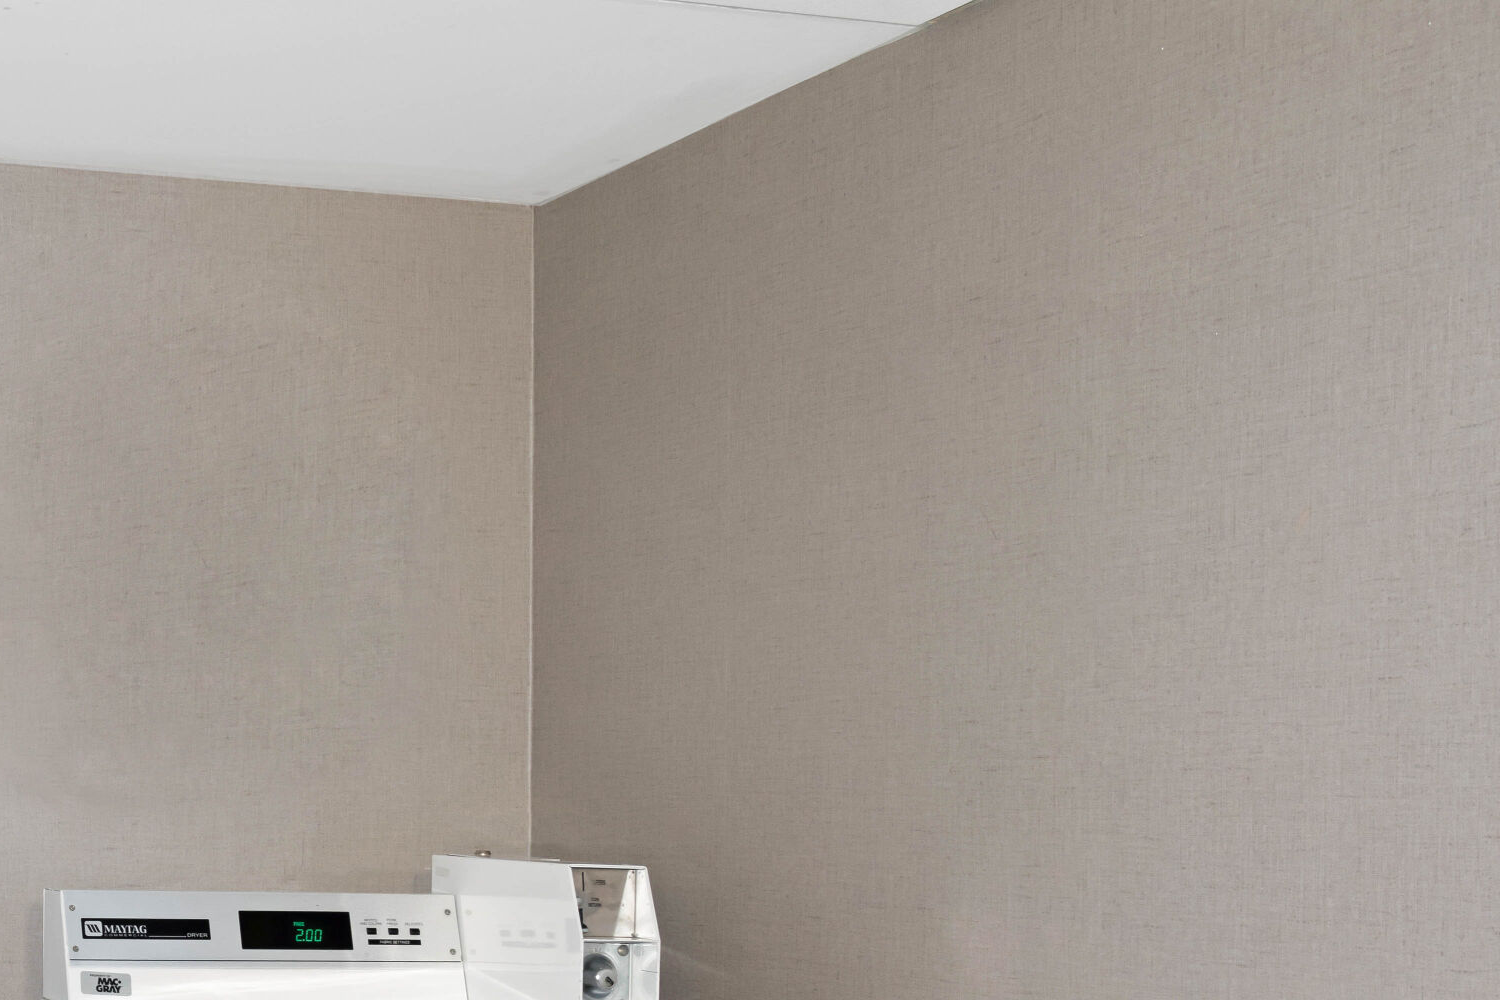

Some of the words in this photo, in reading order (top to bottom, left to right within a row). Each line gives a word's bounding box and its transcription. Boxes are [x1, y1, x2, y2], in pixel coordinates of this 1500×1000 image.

[103, 924, 148, 934] MAYTAG
[295, 928, 323, 942] 2.00
[95, 985, 121, 994] GRAY
